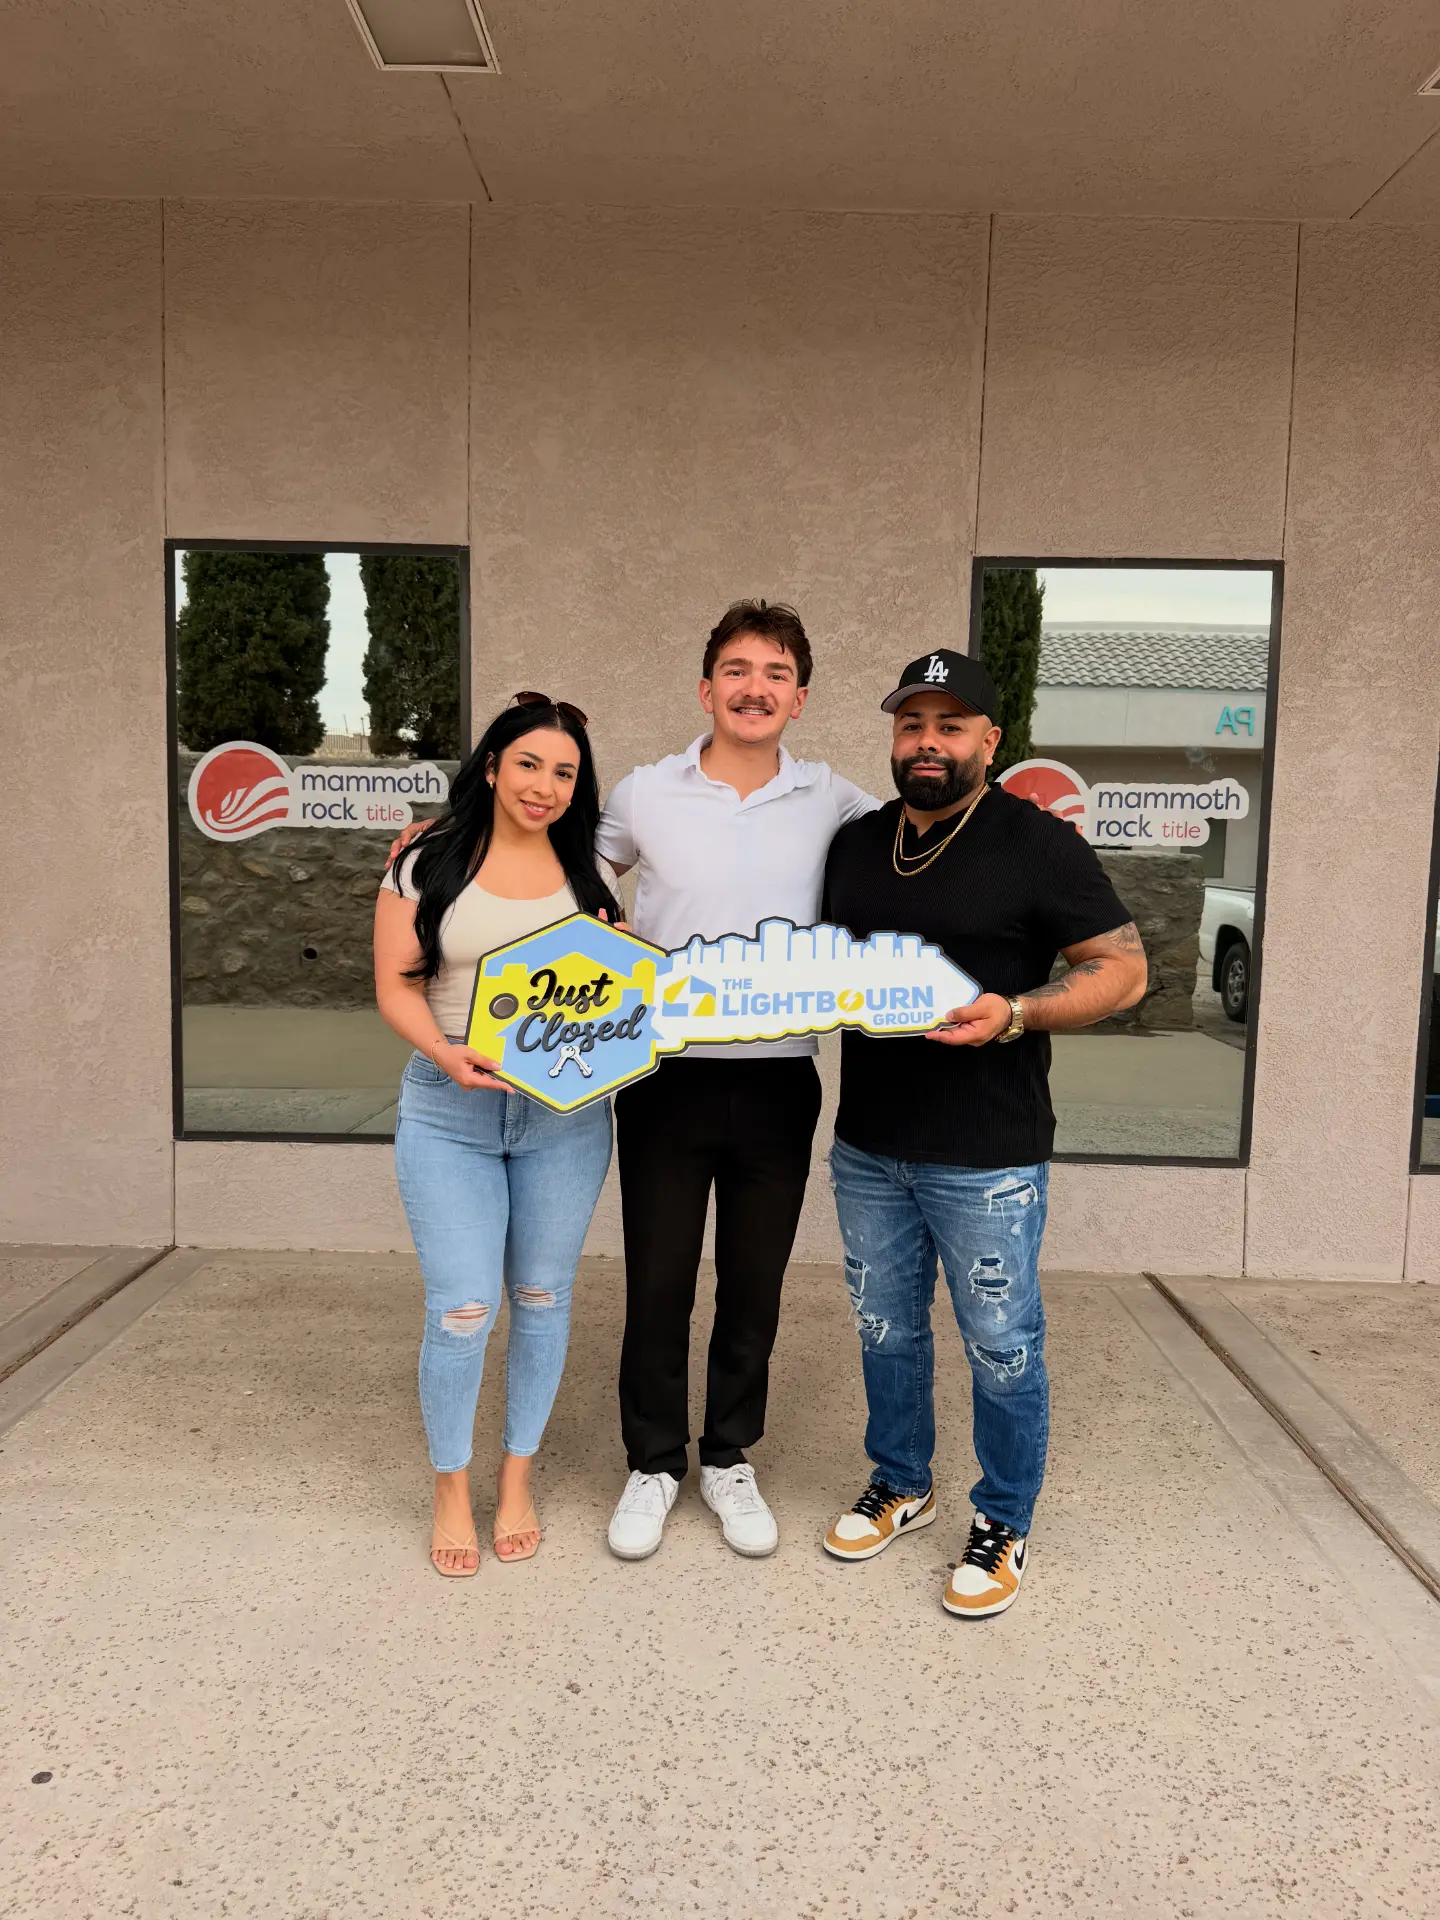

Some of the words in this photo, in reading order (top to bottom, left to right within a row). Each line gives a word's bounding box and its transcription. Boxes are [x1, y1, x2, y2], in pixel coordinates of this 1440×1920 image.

[924, 655, 949, 682] LA
[301, 771, 441, 794] mammoth
[302, 797, 358, 821] rock
[366, 804, 404, 822] title
[1097, 787, 1241, 811] mammoth
[1096, 814, 1153, 838] rock
[1162, 821, 1201, 839] title
[527, 968, 614, 1014] Just
[722, 978, 753, 990] THE
[722, 985, 934, 1016] LIGHTBOURN
[515, 1004, 647, 1052] Closed
[873, 1011, 934, 1026] GROUP
